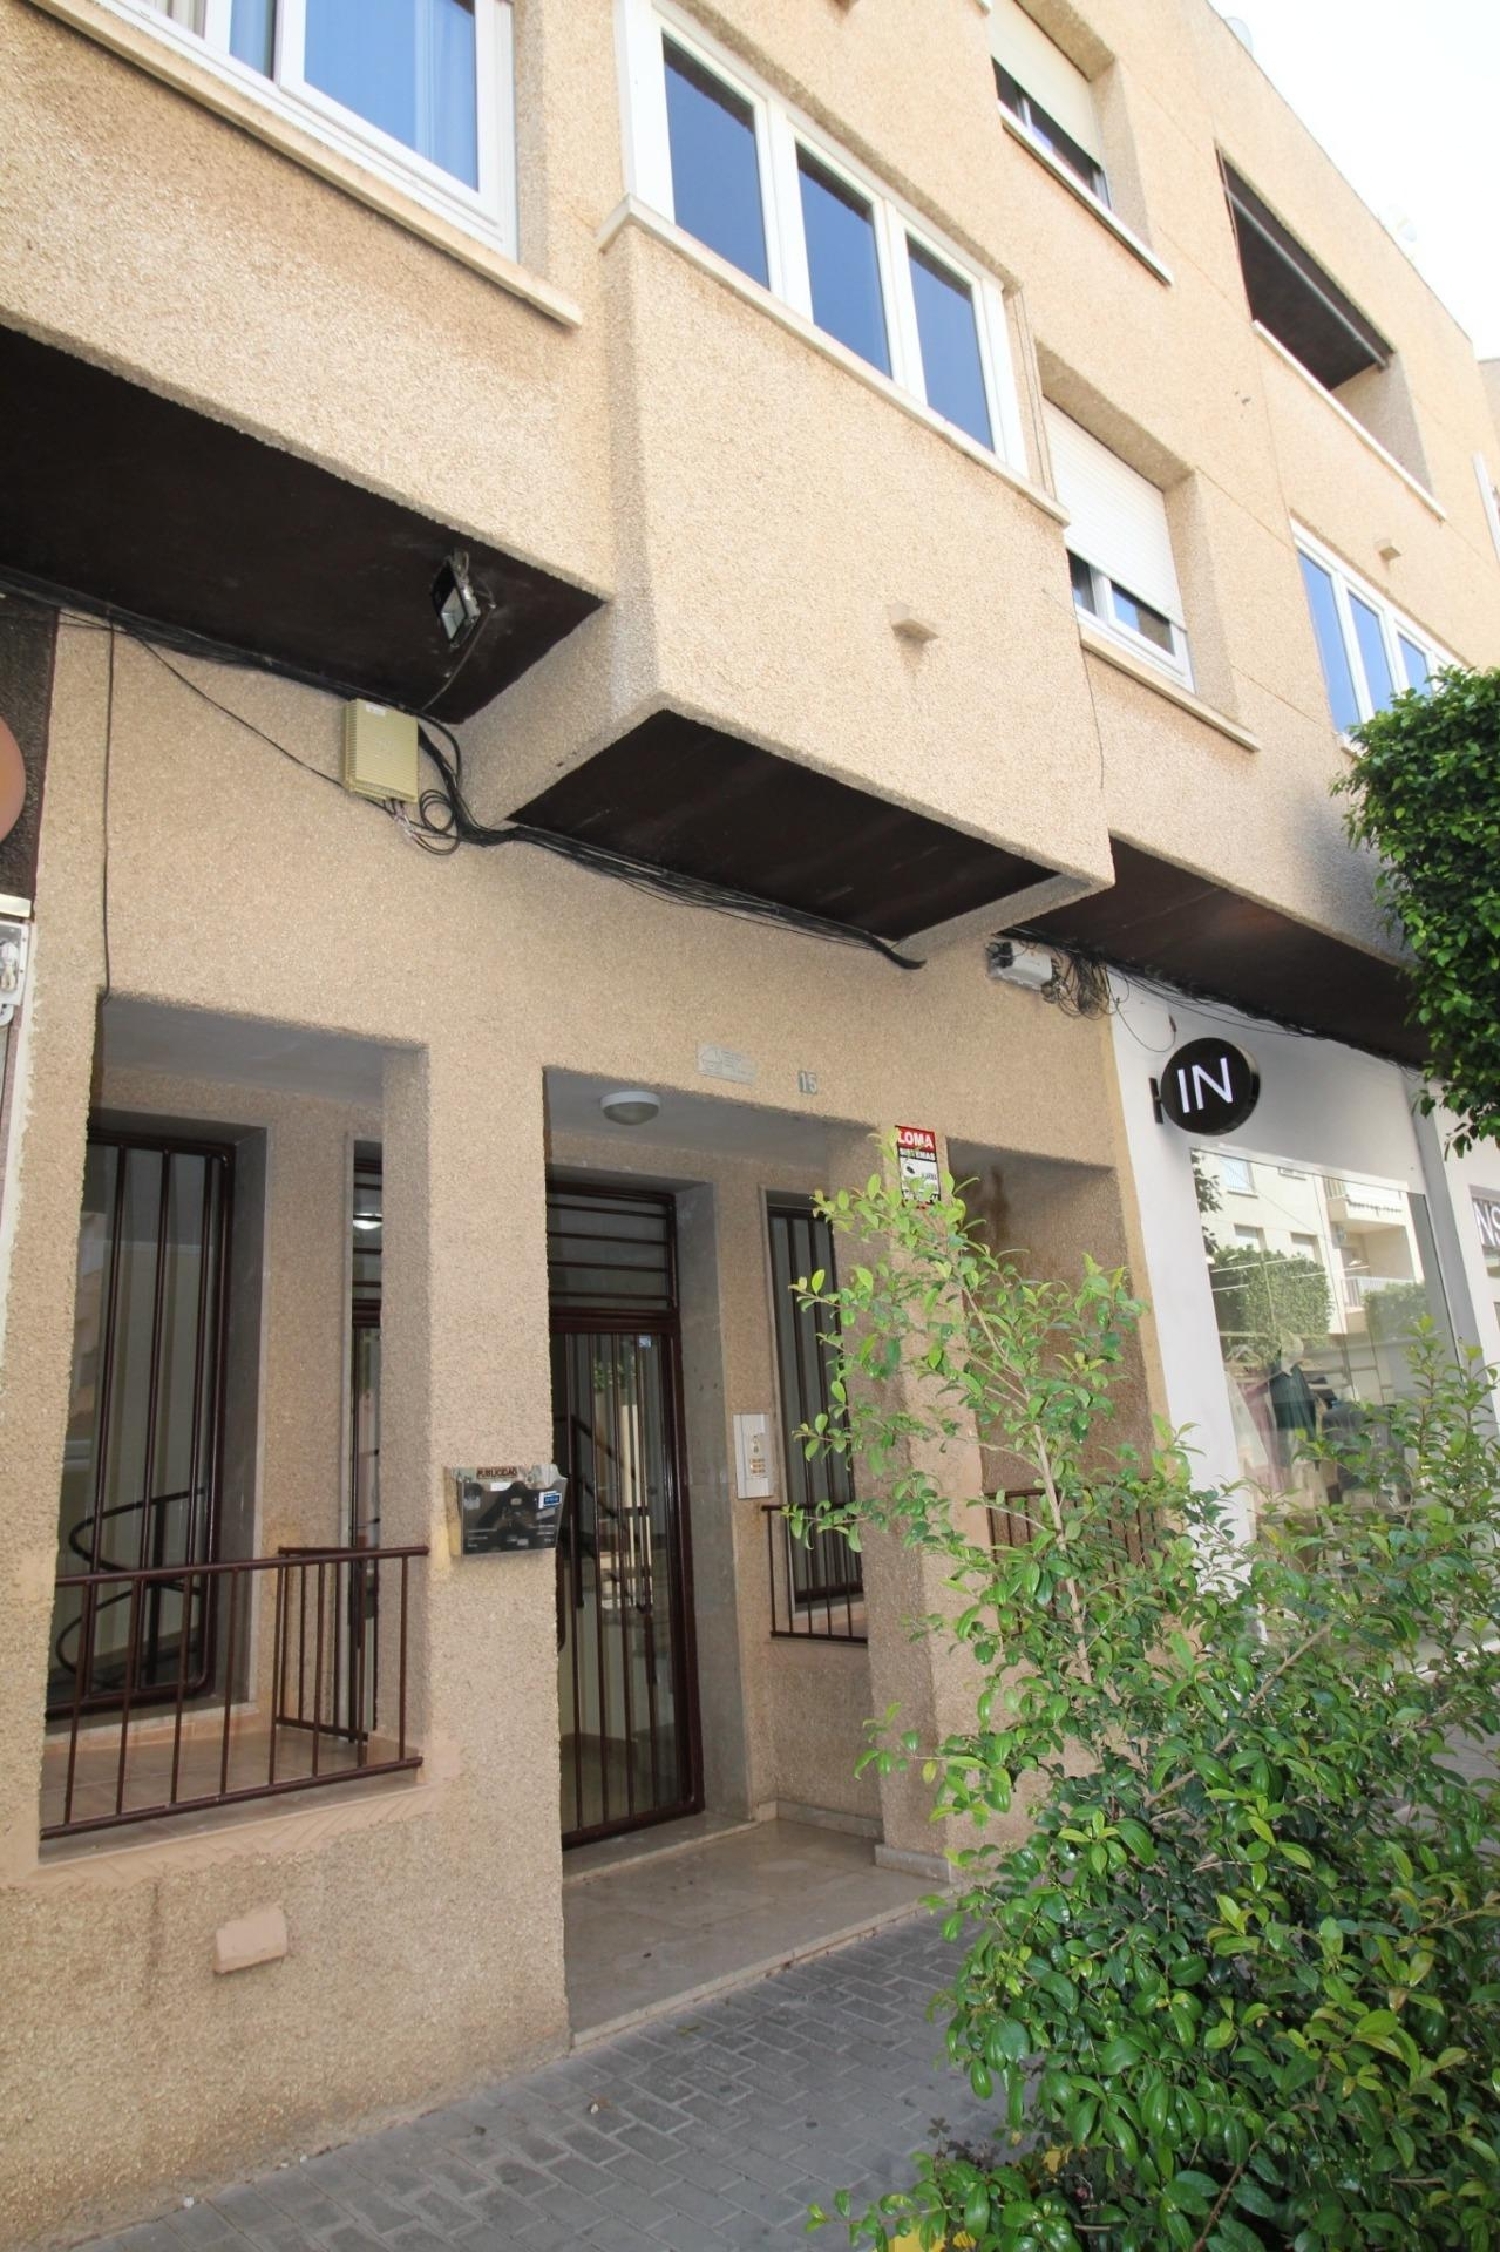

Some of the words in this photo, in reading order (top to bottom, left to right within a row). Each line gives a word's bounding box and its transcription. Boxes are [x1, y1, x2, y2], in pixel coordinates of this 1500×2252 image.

[800, 1071, 817, 1094] 15
[1177, 1057, 1233, 1113] IN
[897, 1130, 935, 1149] LOMA
